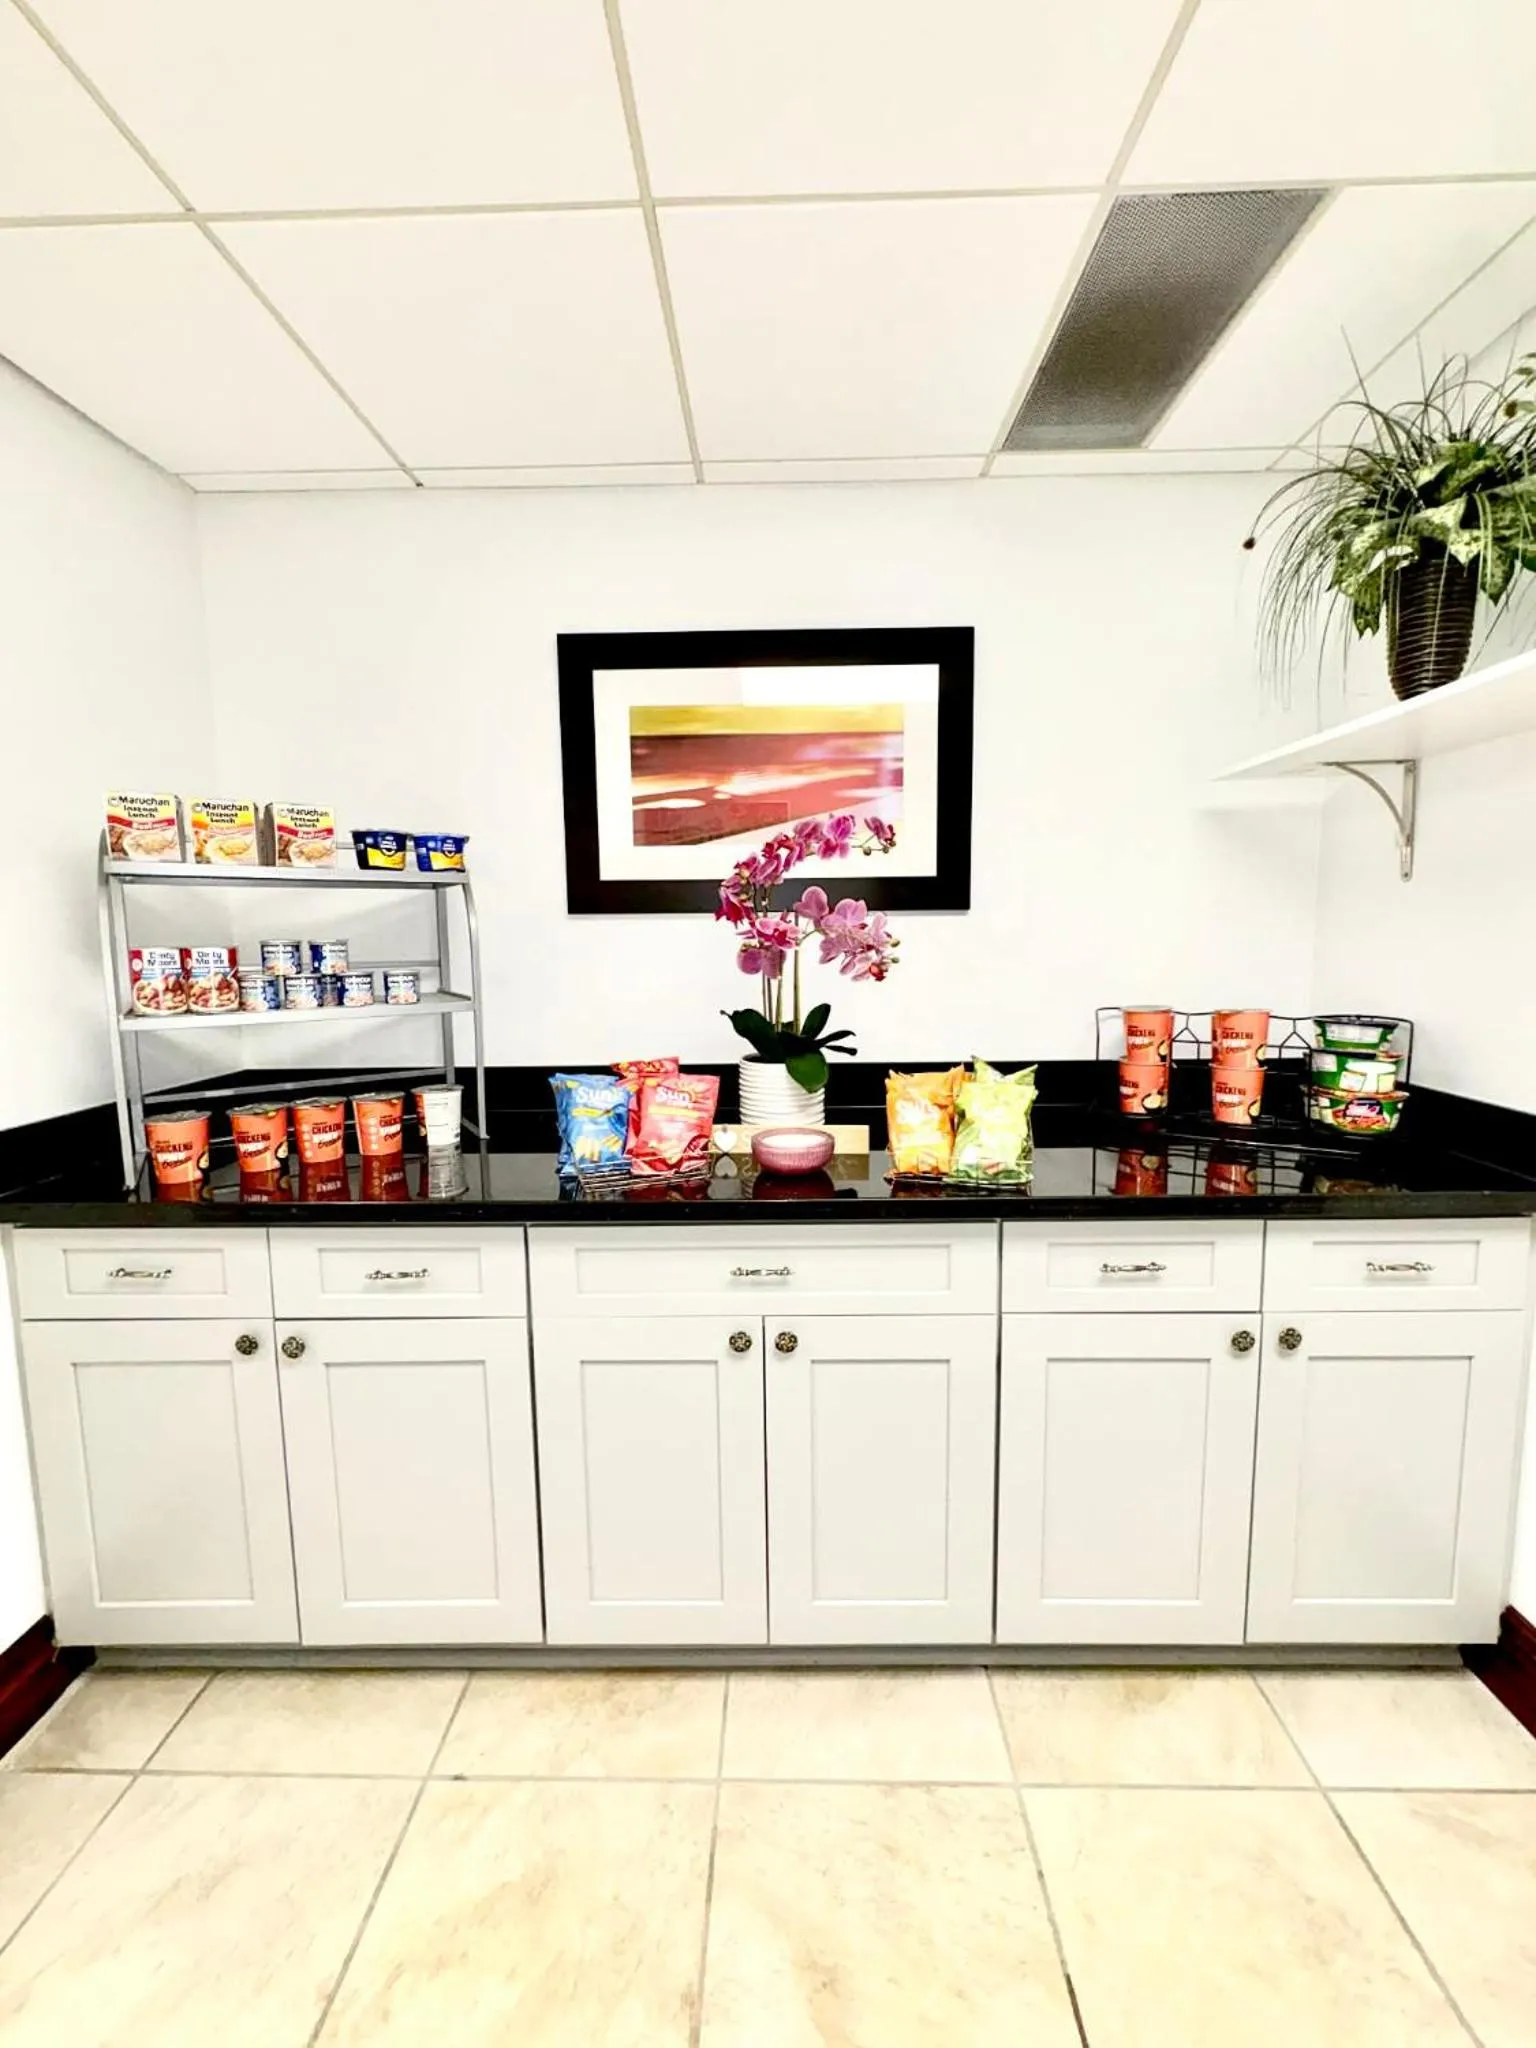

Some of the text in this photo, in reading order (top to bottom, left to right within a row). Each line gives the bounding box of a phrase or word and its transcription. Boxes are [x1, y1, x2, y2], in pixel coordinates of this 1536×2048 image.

[118, 795, 171, 807] Maruchan
[201, 802, 250, 812] Maruchan
[286, 807, 330, 817] Maruchan
[576, 1086, 612, 1103] Sun
[655, 1088, 689, 1103] Sun
